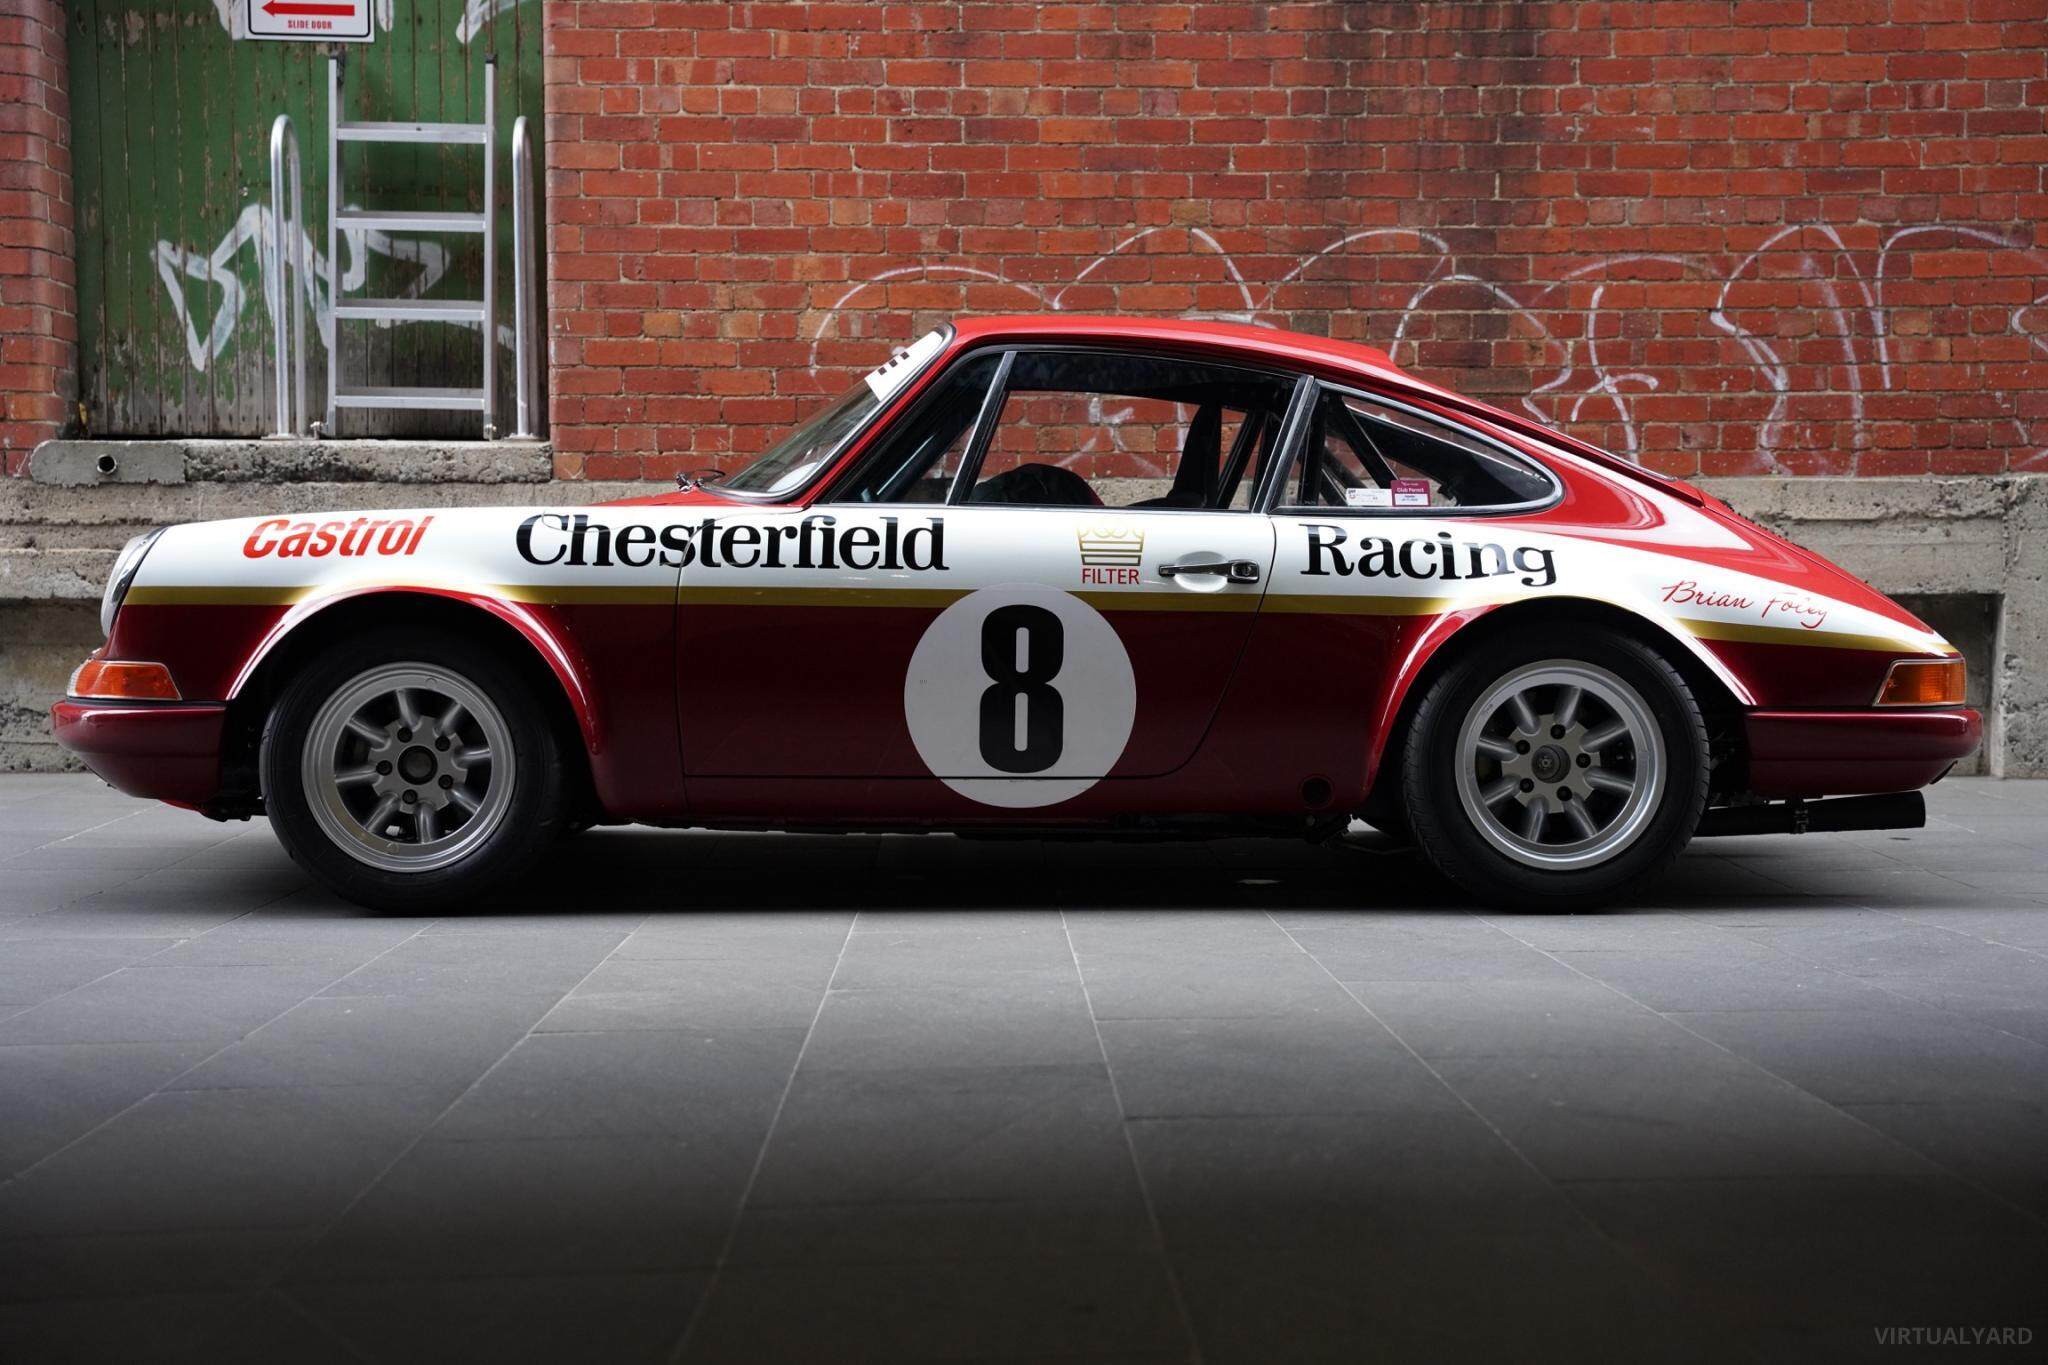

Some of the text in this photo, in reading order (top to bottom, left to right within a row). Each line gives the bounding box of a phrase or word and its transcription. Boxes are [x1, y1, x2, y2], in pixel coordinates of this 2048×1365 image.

[287, 19, 332, 30] SLIDE DOOR
[242, 515, 435, 559] Castrol
[515, 513, 1557, 588] Chesterfield Racing
[1081, 568, 1140, 585] FILTER
[1661, 580, 1754, 610] Brian
[979, 604, 1064, 774] 8
